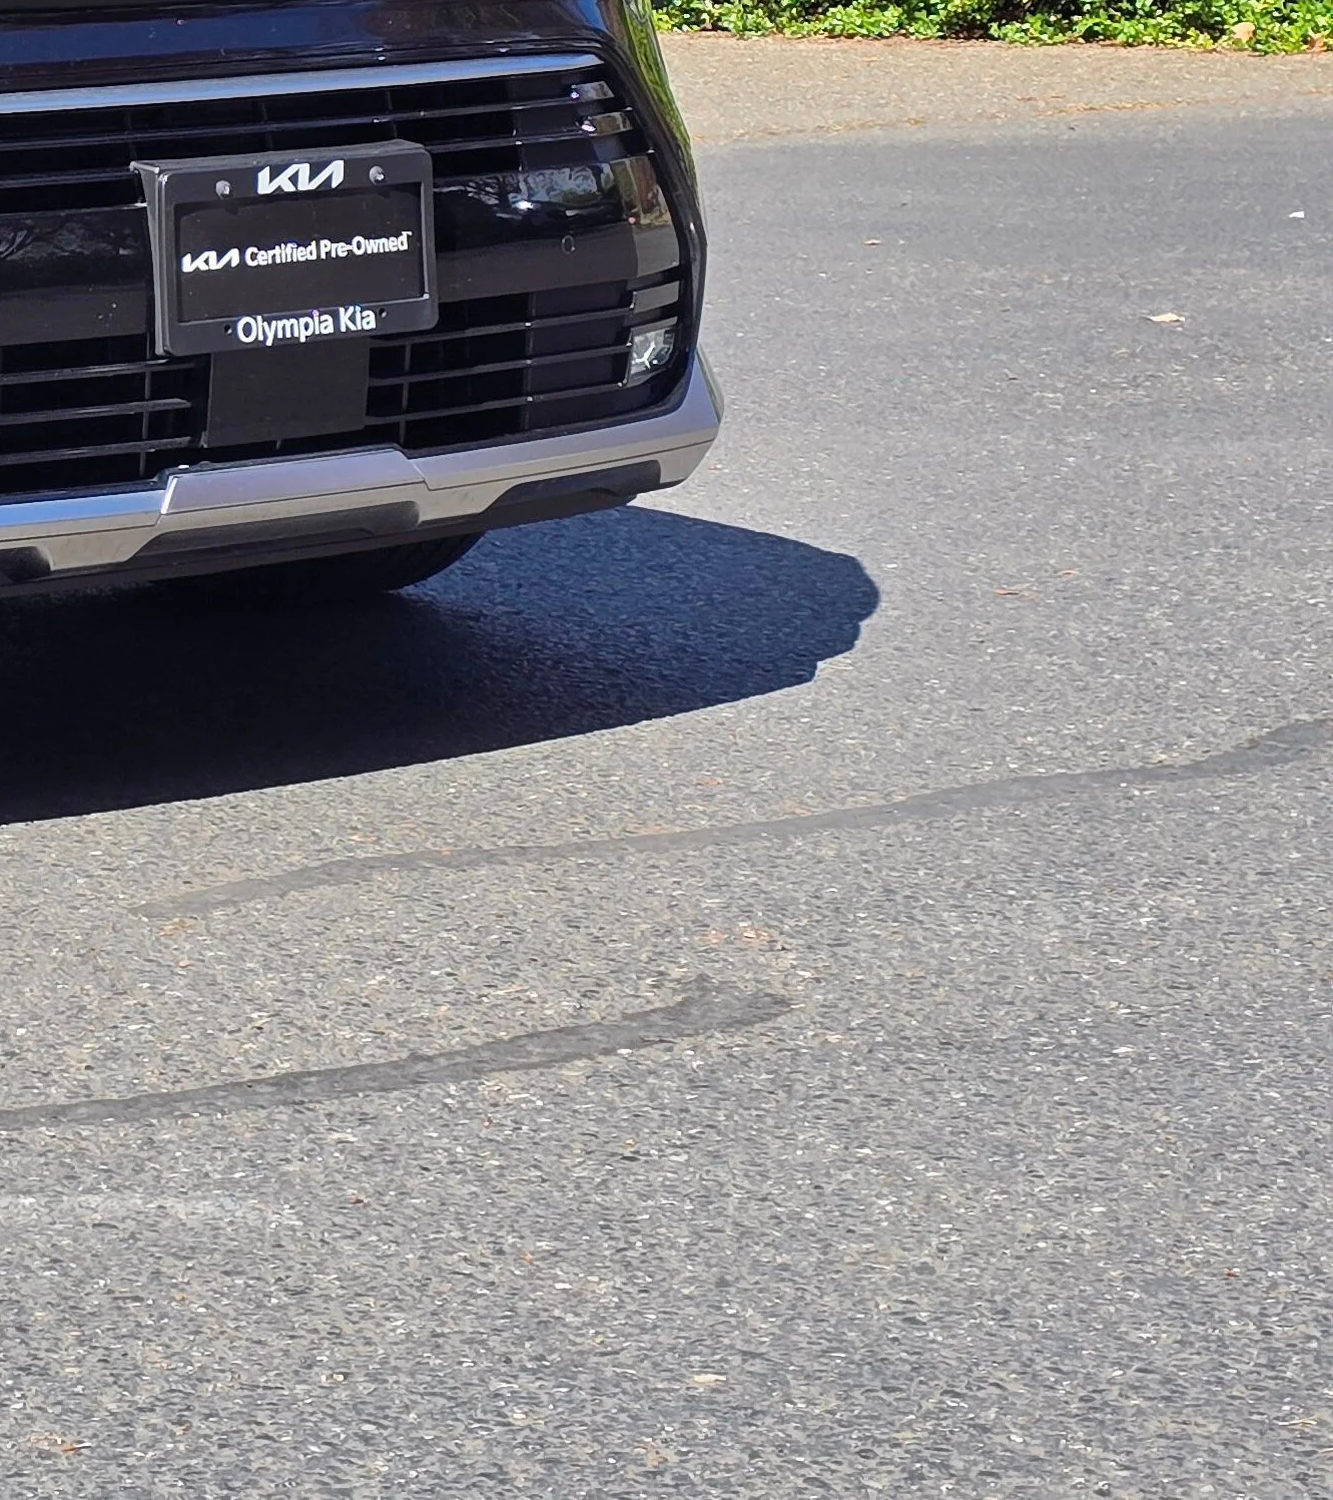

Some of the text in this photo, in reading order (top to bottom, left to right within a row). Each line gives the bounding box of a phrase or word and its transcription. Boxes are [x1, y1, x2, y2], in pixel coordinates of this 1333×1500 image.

[256, 159, 345, 195] KIA
[182, 248, 240, 273] KIA
[245, 240, 317, 267] Certified
[237, 304, 377, 347] Olympia Kia
